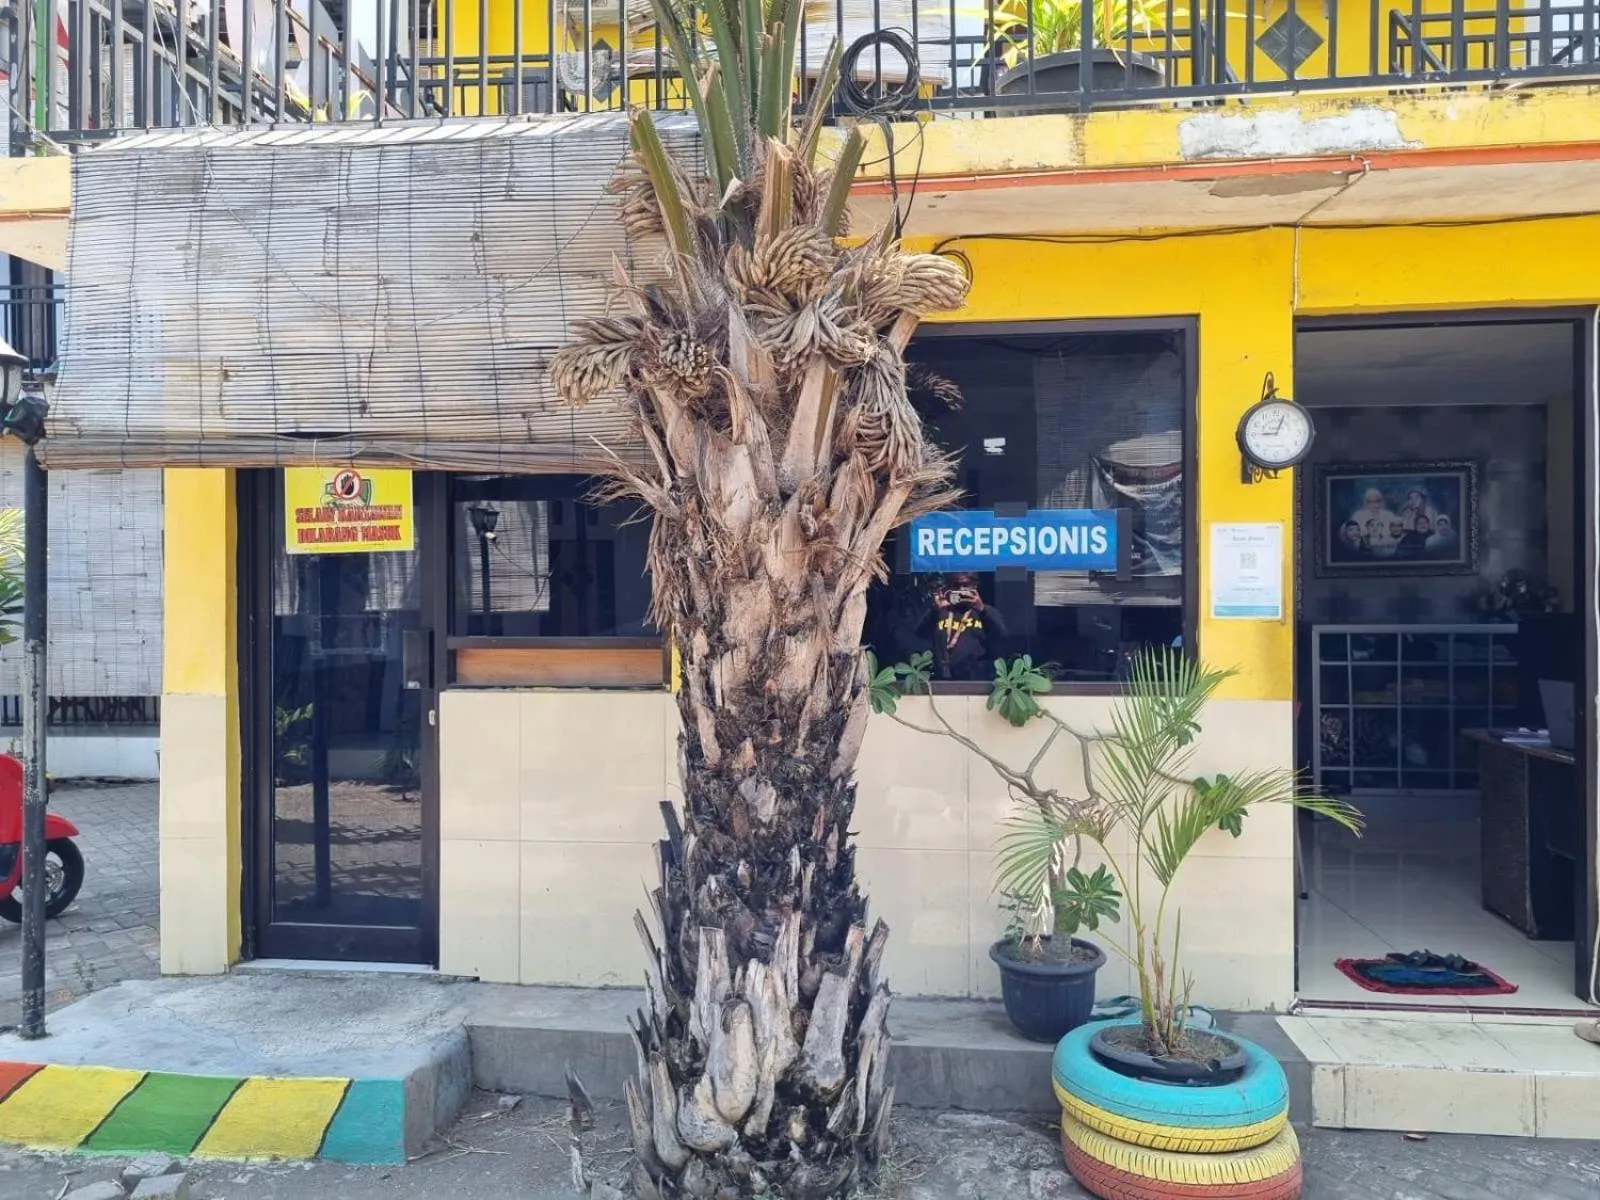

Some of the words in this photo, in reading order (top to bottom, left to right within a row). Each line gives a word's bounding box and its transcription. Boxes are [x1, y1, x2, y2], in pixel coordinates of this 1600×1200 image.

[297, 526, 358, 544] DILARANG
[361, 524, 402, 542] MASUK
[918, 525, 1108, 556] RECEPSIONIS
